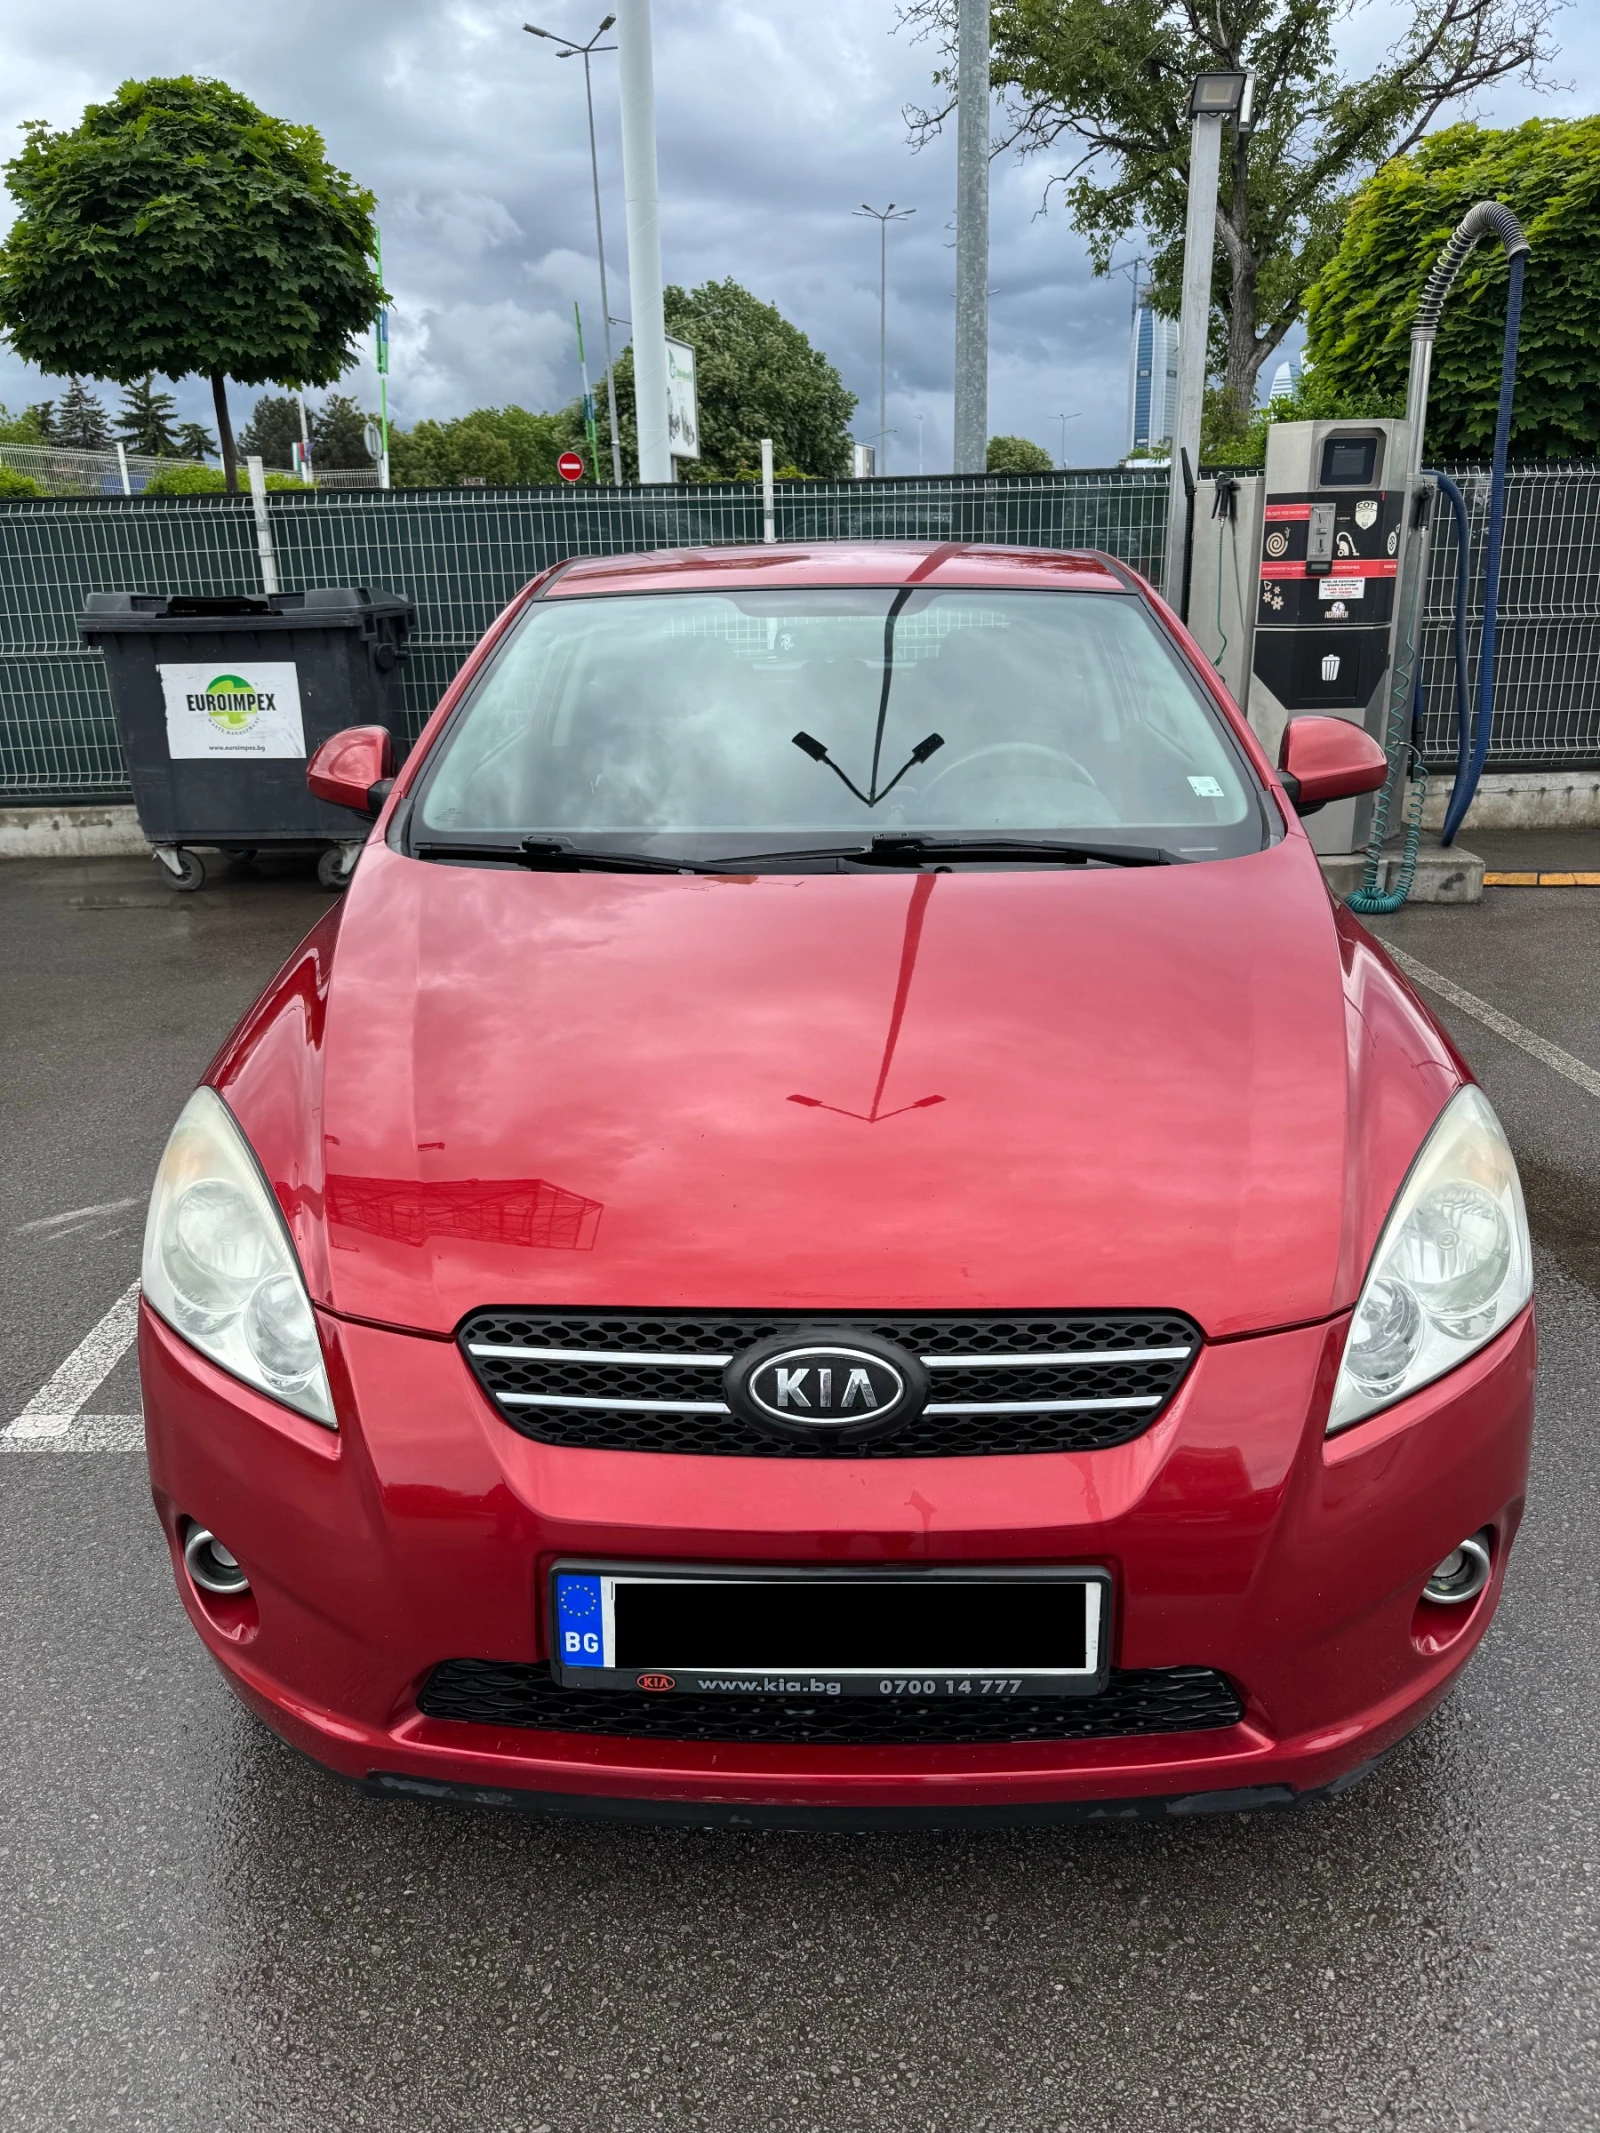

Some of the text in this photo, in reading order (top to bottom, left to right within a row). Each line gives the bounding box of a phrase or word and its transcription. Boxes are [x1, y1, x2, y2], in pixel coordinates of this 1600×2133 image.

[186, 693, 277, 712] EUROIMPEX
[774, 1368, 879, 1408] KIA
[564, 1631, 600, 1653] BG
[643, 1676, 670, 1688] KIA
[698, 1678, 842, 1695] www.kia.bg
[879, 1680, 1023, 1694] 0700 14 777
